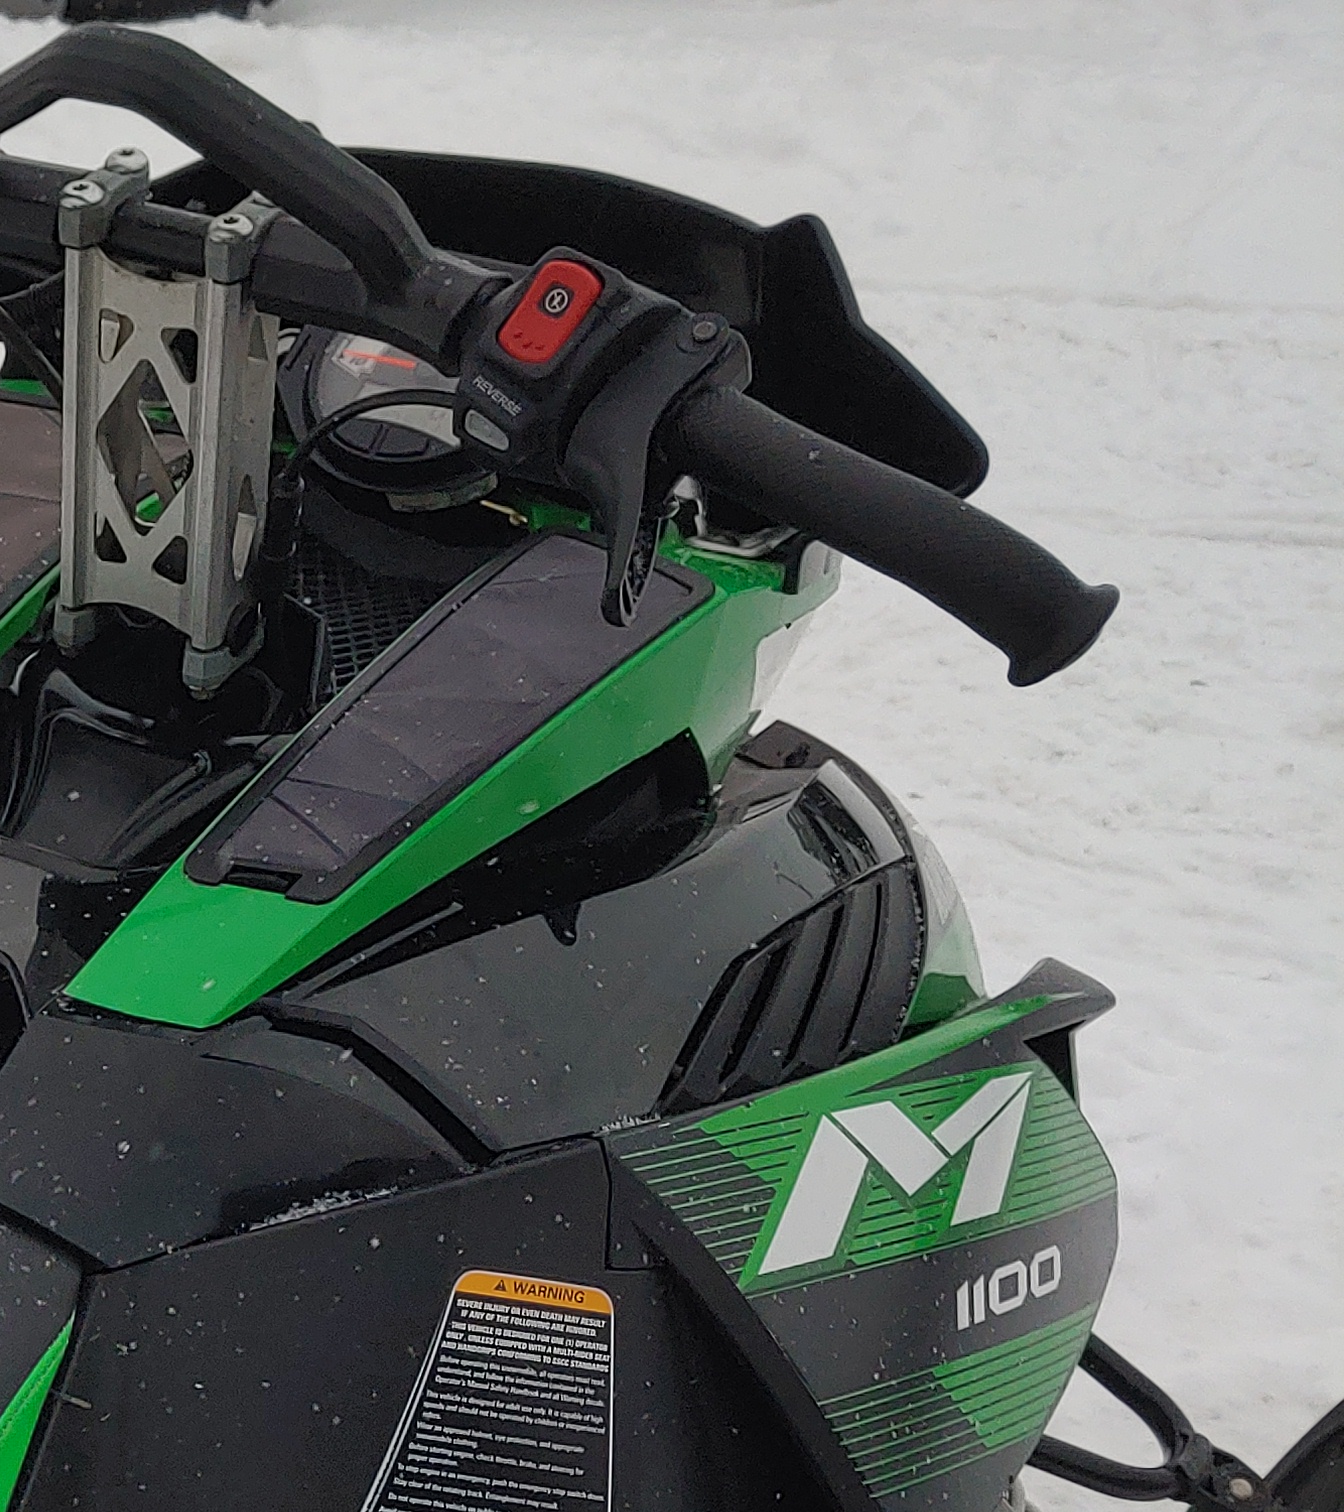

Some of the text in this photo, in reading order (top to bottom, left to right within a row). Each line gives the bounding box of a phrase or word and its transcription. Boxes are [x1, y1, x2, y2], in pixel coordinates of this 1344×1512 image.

[473, 375, 522, 417] REVERSE
[759, 1071, 1034, 1275] M
[513, 1281, 585, 1304] WARNING
[956, 1244, 1062, 1331] 1100
